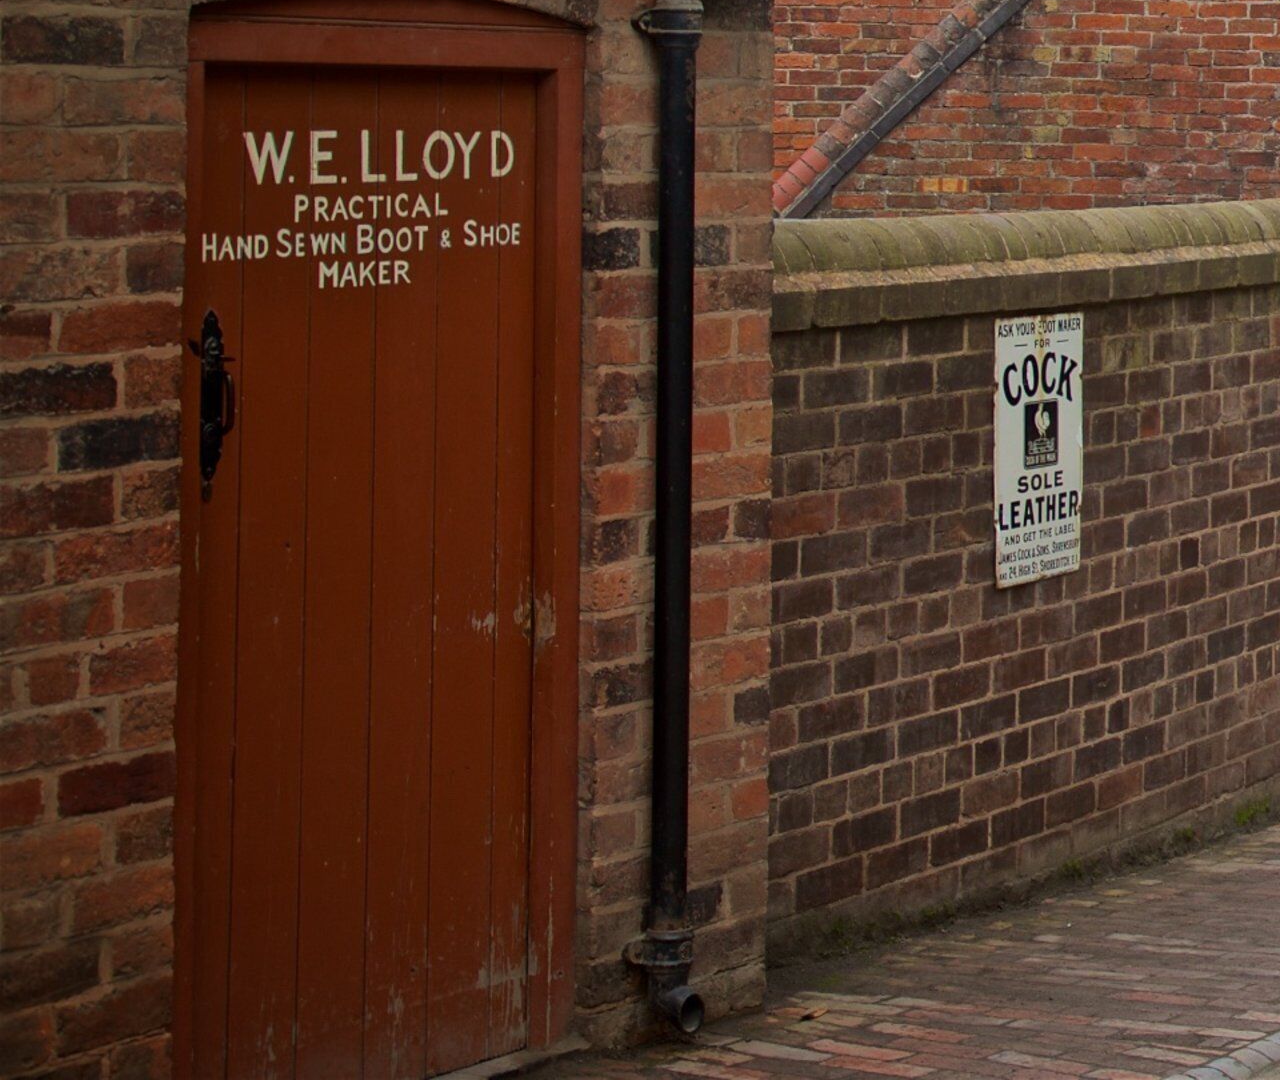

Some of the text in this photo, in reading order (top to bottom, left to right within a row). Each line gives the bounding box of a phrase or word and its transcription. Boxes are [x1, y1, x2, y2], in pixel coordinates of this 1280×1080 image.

[361, 129, 515, 183] LLOYD
[294, 192, 449, 223] PRACTICAL
[202, 220, 521, 263] HAND SEWN BOOT & SHOE
[318, 260, 411, 289] MAKER
[998, 324, 1014, 338] ASK
[1016, 322, 1035, 336] YOUR
[1058, 317, 1081, 331] MAKER
[1034, 338, 1050, 348] FOR
[1002, 351, 1078, 407] COCK
[1017, 470, 1063, 494] SOLE
[999, 490, 1079, 531] LEATHER
[1004, 523, 1076, 546] AND GET THE LABEL
[1017, 548, 1031, 560] COCK
